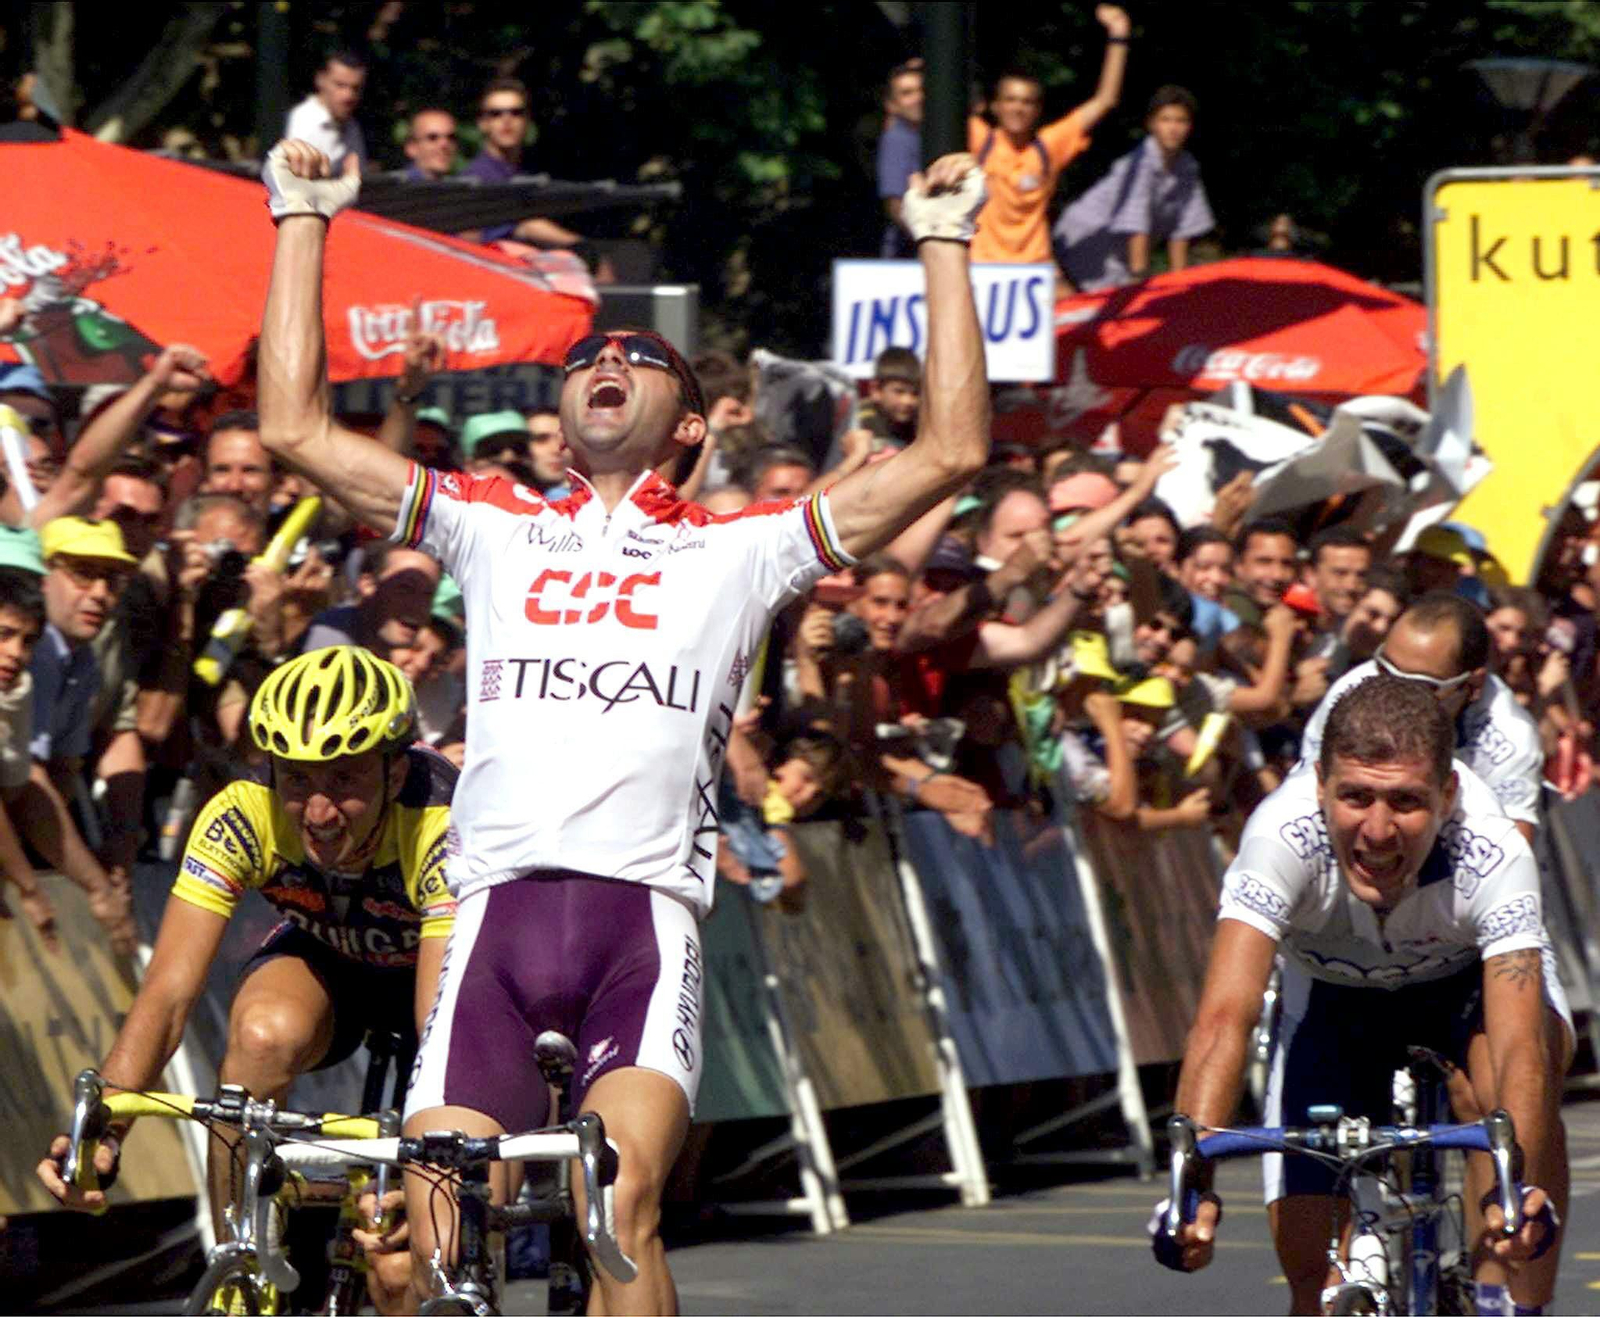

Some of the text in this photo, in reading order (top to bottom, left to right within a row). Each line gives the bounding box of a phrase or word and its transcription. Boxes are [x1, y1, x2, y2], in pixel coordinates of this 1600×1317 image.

[845, 276, 1044, 364] INSUS
[524, 567, 663, 630] CSC
[508, 658, 701, 714] TISCALI
